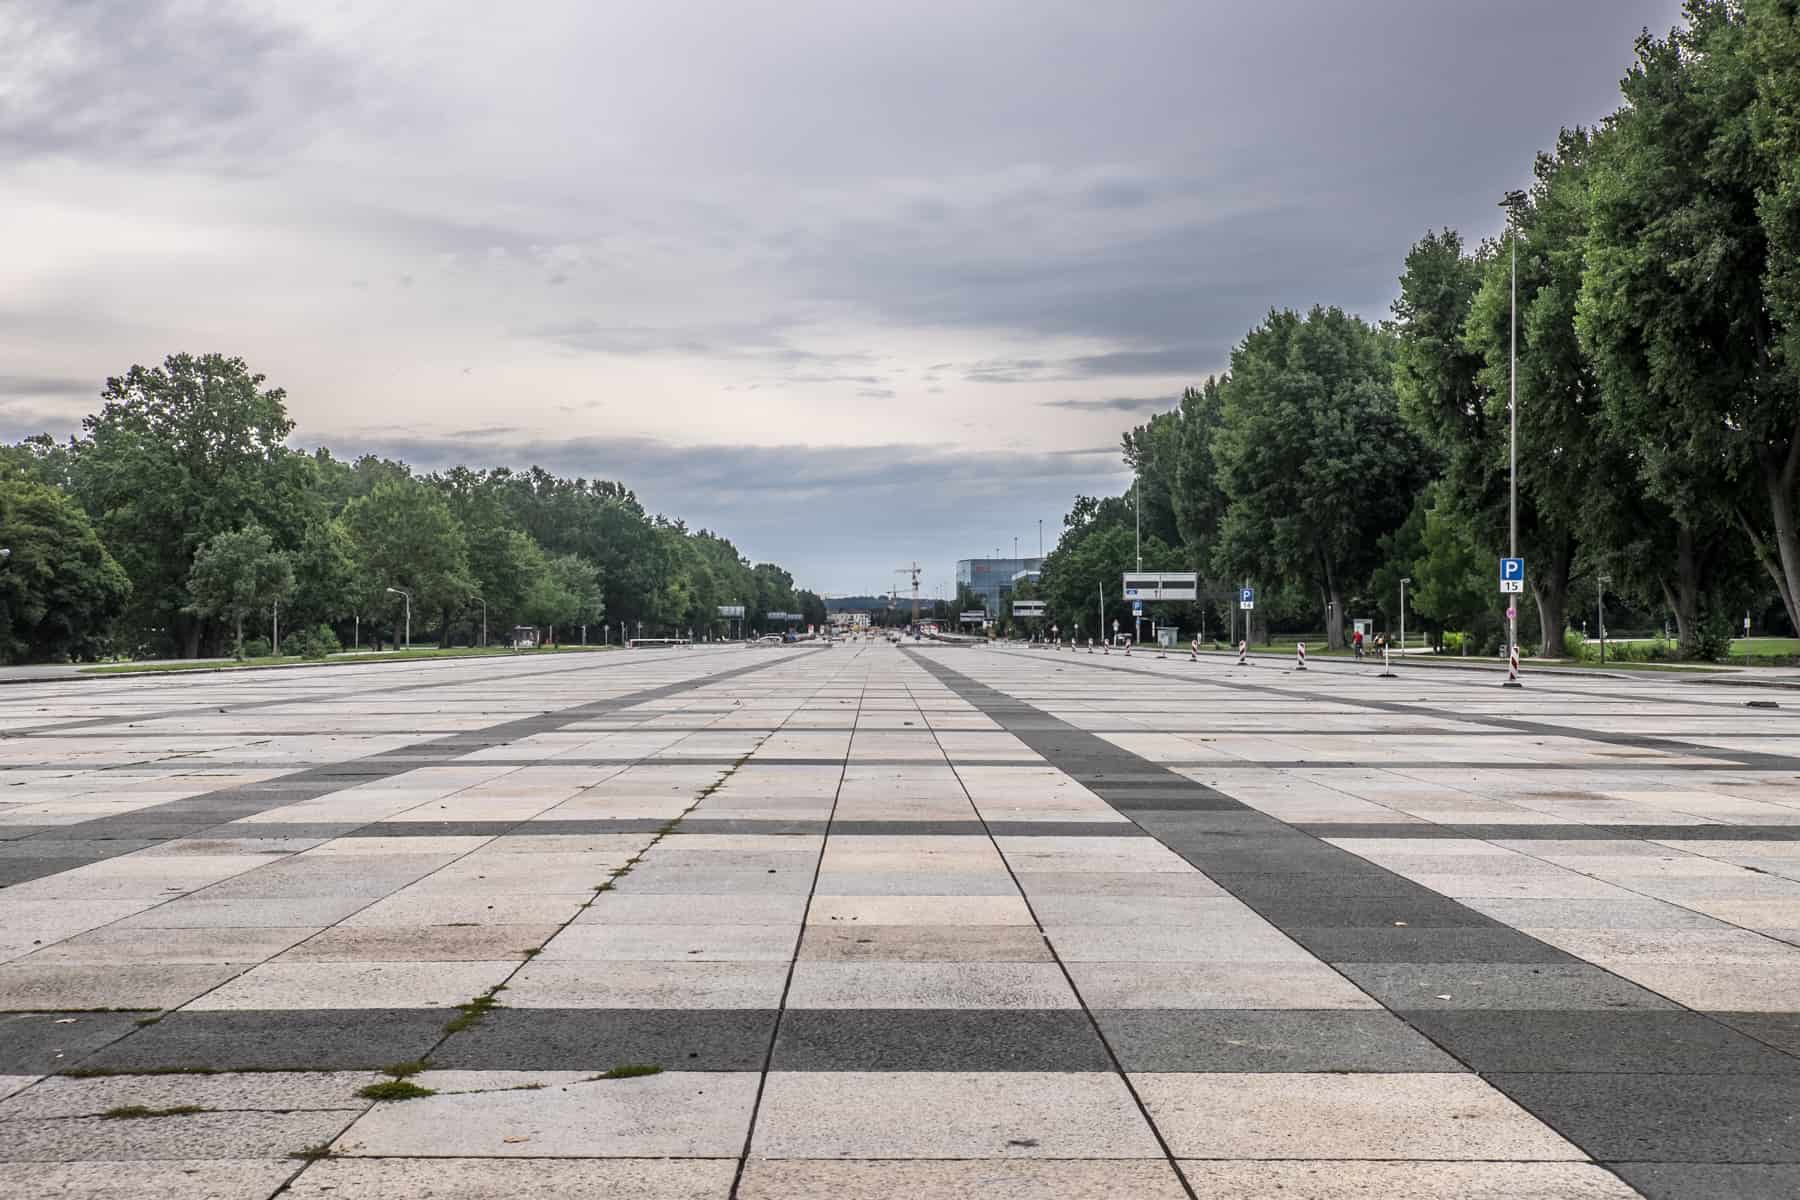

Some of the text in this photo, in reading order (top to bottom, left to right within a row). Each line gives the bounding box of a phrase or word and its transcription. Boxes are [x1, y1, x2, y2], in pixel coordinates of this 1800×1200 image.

[1506, 560, 1518, 579] P
[1505, 582, 1518, 591] 15
[1243, 590, 1251, 601] P
